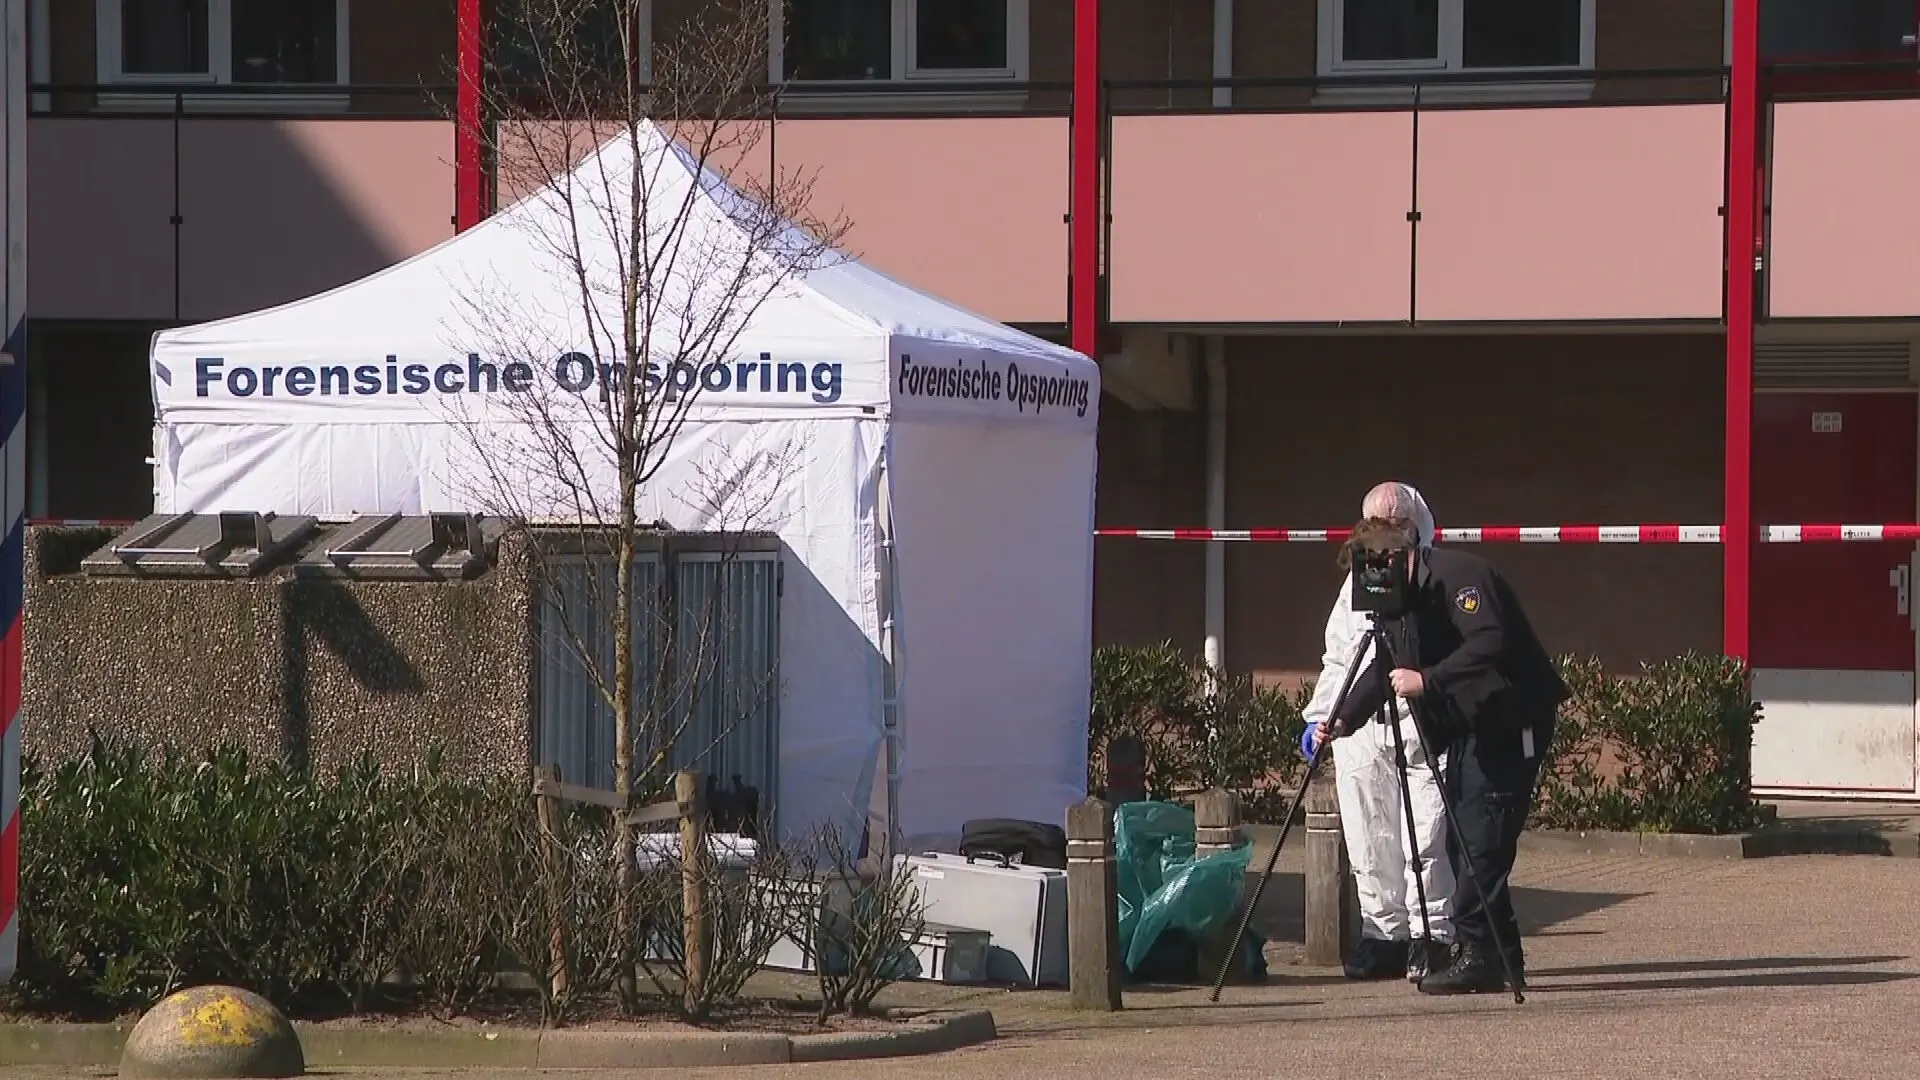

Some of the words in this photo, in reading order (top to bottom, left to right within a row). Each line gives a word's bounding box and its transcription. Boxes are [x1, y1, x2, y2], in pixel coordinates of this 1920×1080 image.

[195, 353, 533, 397] Forensische
[555, 351, 842, 403] Opsporing
[899, 354, 1000, 401] Forensische
[1007, 362, 1089, 418] Opsporing
